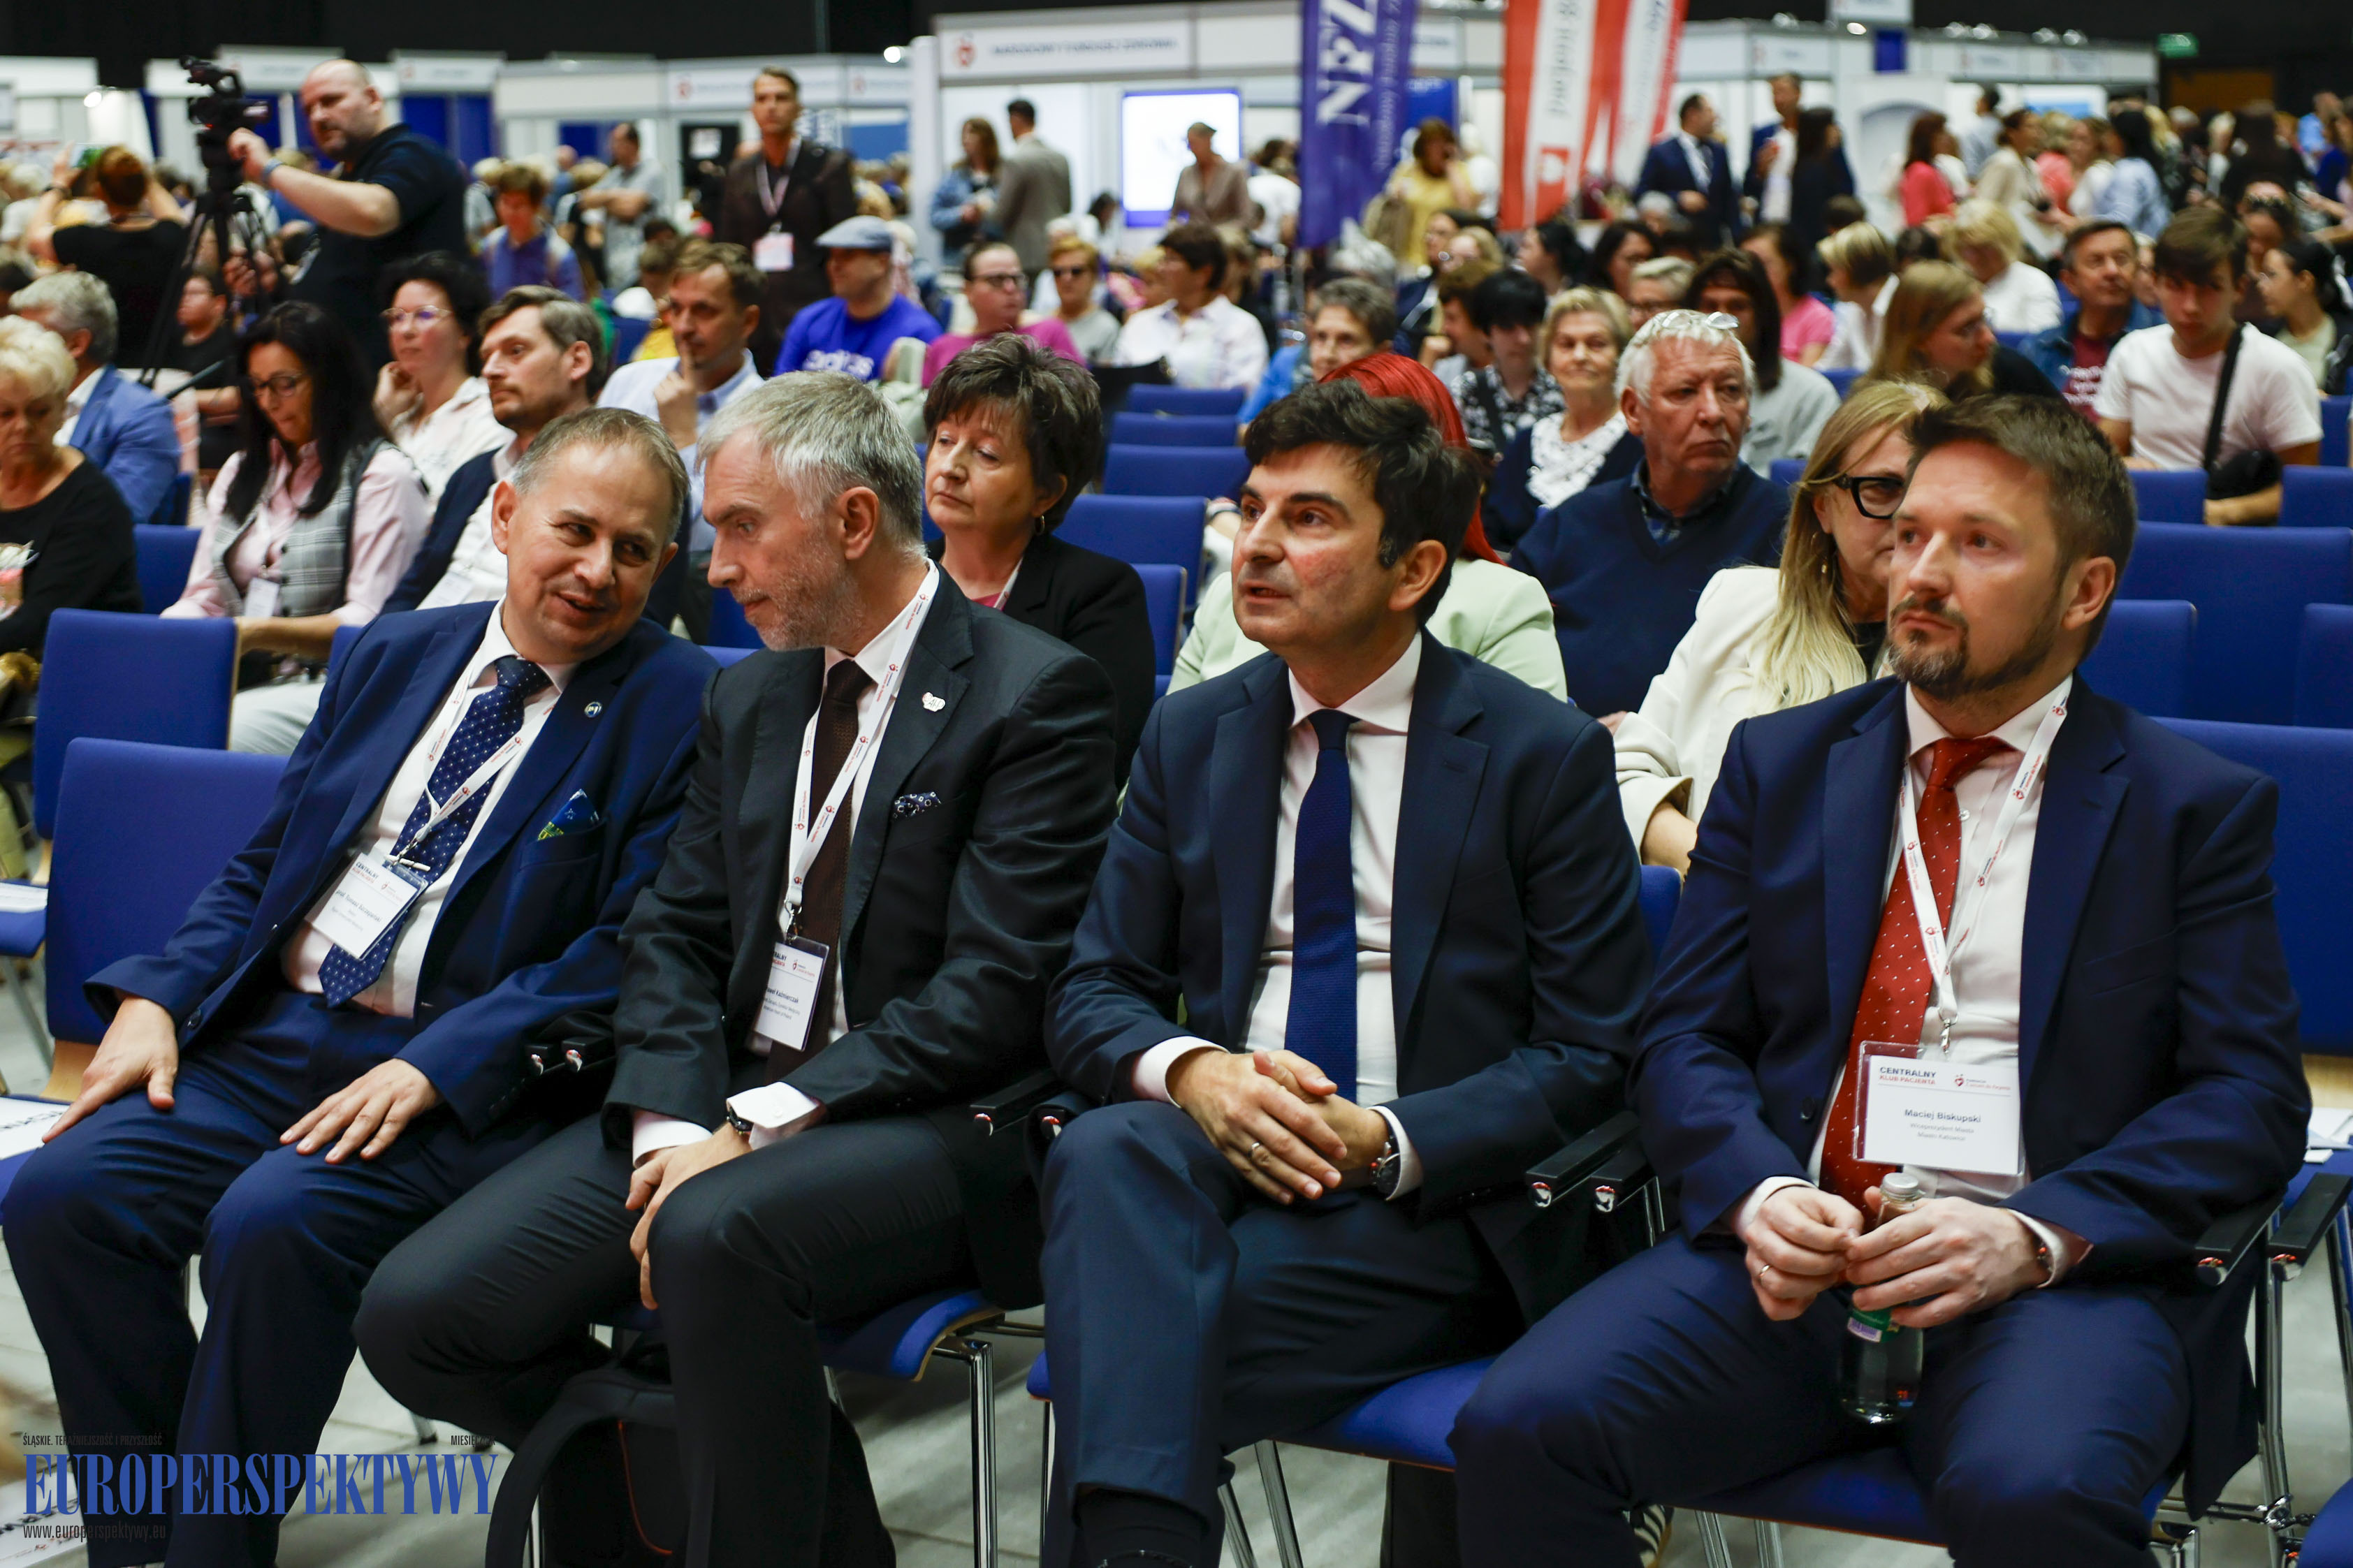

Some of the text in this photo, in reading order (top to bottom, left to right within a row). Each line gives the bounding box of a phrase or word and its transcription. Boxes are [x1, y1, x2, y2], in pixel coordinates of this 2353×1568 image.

[1880, 1067, 1937, 1078] CENTRALNY
[1900, 1076, 1936, 1085] PACJENTA
[1904, 1109, 1981, 1123] Maciej Biskupski
